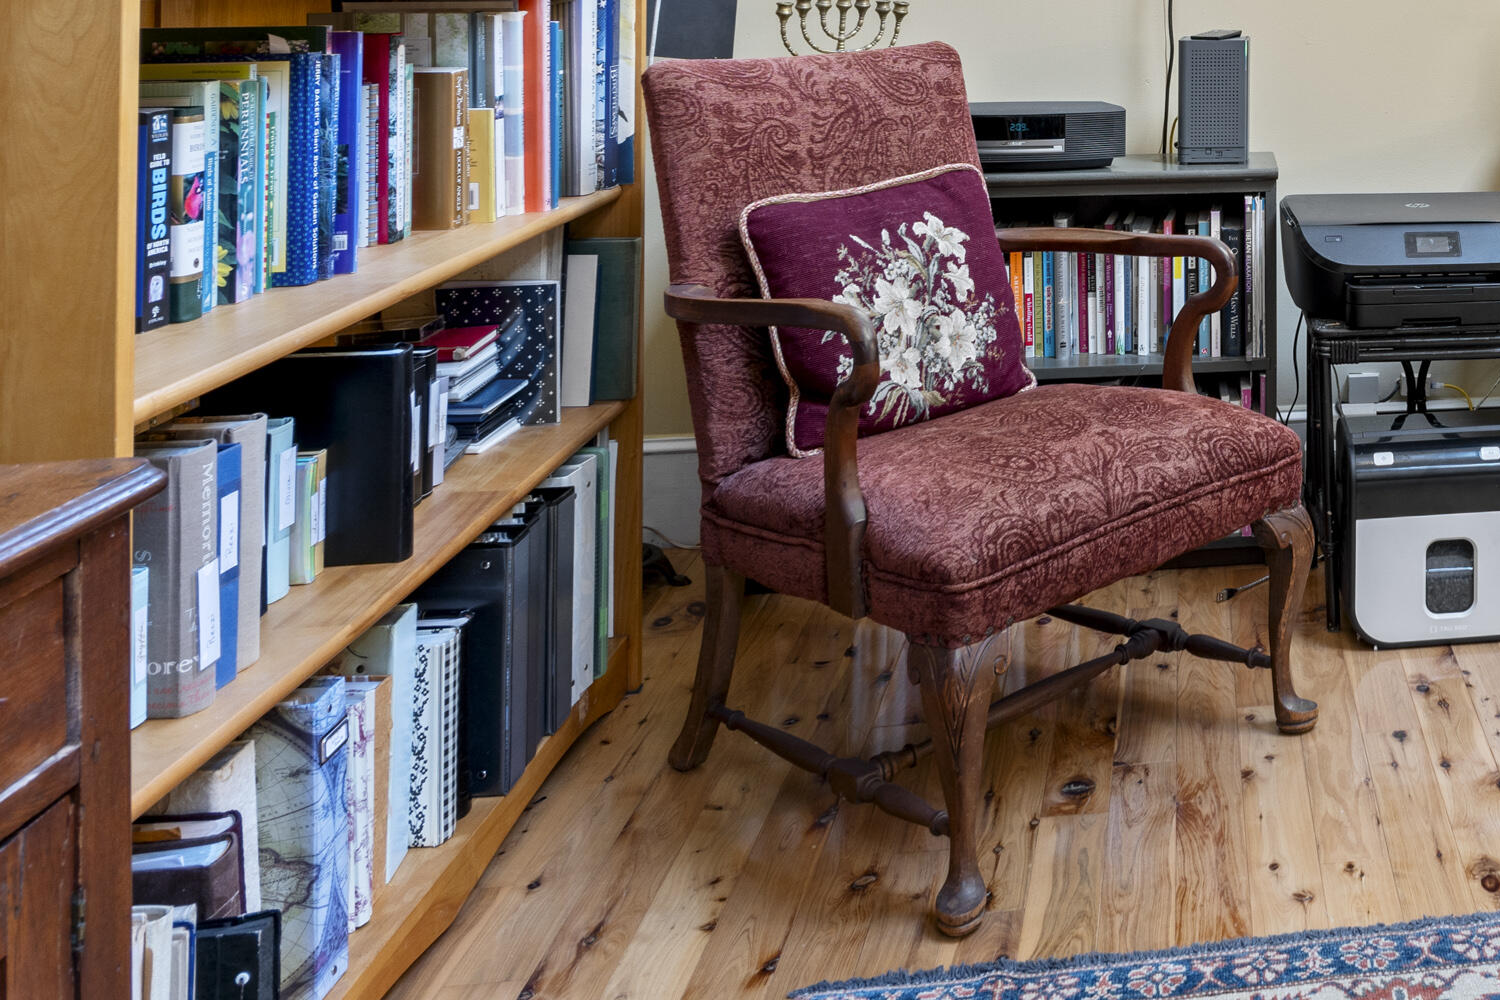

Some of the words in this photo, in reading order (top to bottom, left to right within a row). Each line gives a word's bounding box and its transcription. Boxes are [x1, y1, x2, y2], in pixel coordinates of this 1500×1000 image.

[455, 97, 464, 126] Burnham
[239, 91, 250, 185] PERENNIALS
[149, 160, 161, 169] GUIDE
[152, 153, 167, 161] FIELD
[312, 178, 318, 191] of
[151, 168, 168, 241] BIRDS
[154, 239, 170, 249] NORTH
[1244, 228, 1252, 254] TIBETAN
[147, 246, 169, 257] AMERICA
[1025, 297, 1034, 324] whistling
